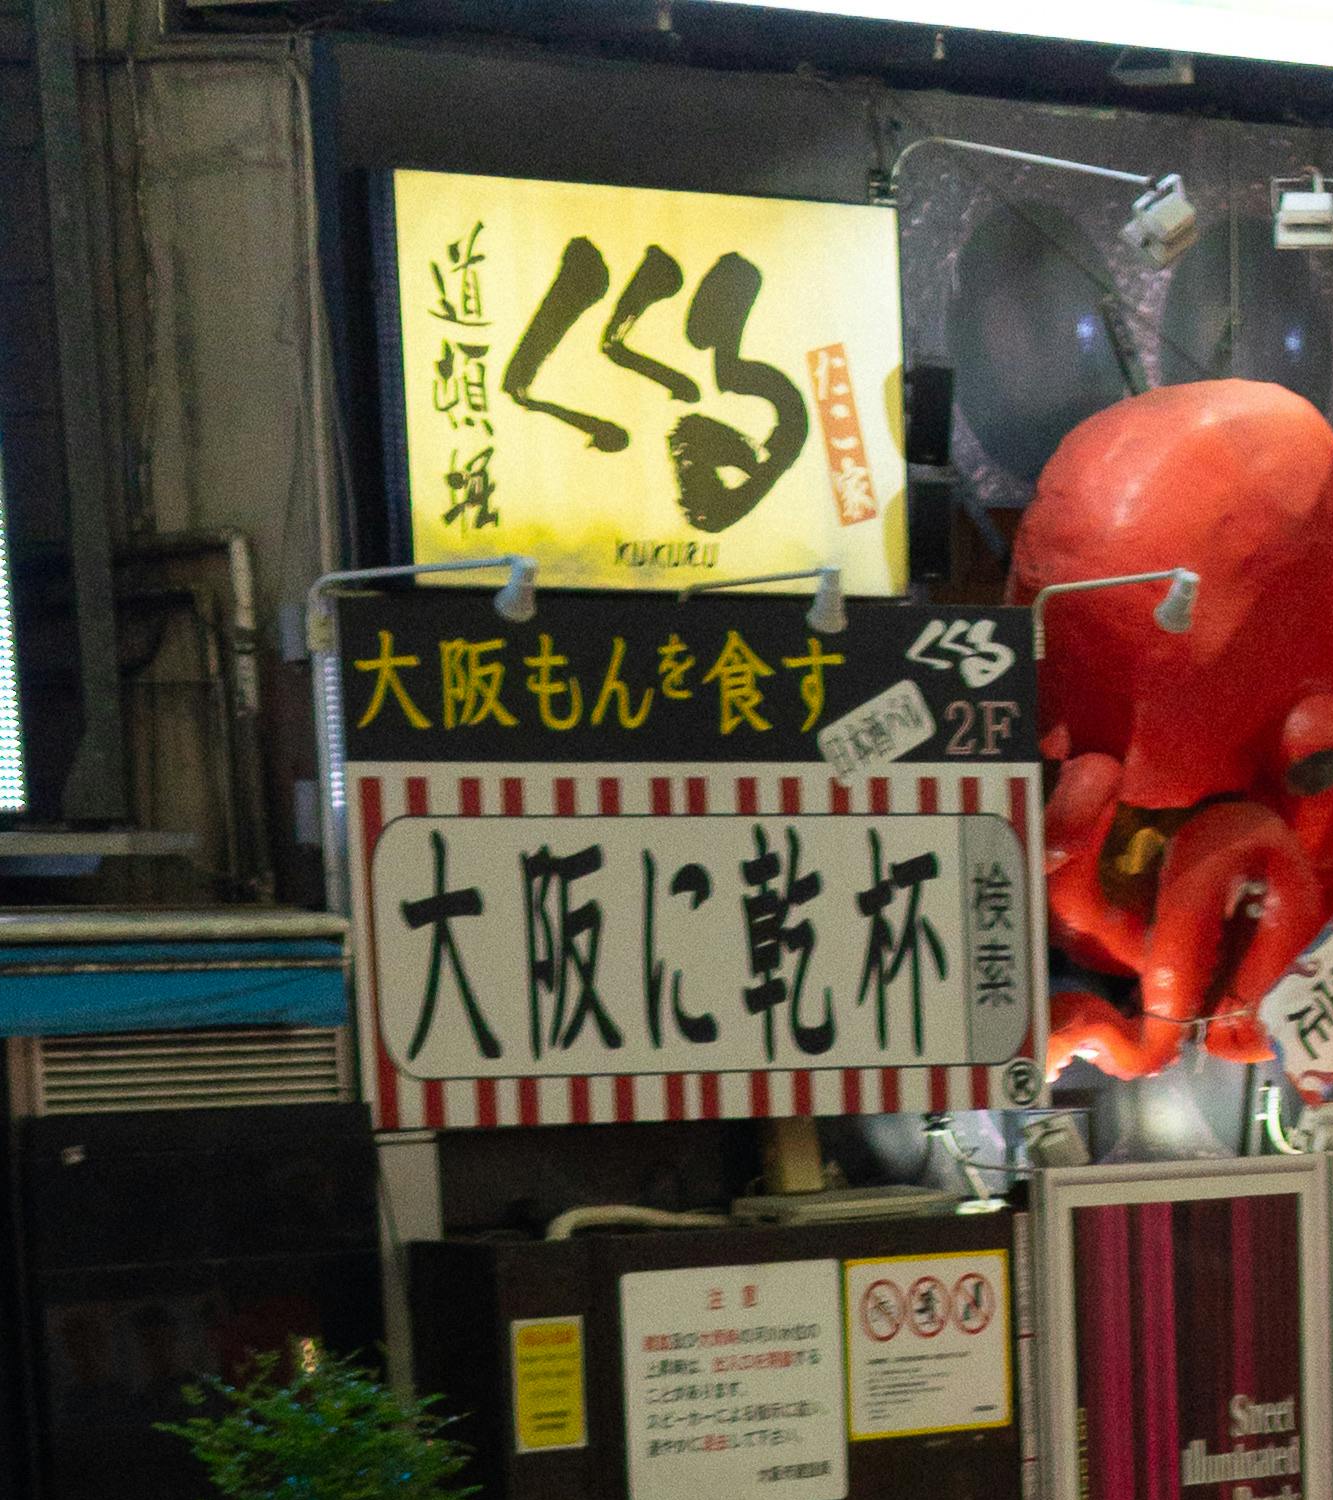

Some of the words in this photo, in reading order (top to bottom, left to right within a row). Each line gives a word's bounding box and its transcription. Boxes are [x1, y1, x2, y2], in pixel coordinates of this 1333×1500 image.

[502, 236, 809, 533] くくる
[355, 629, 846, 736] 大阪もんを食す
[945, 701, 1021, 755] 2F
[402, 824, 948, 1063] 大阪に乾杯
